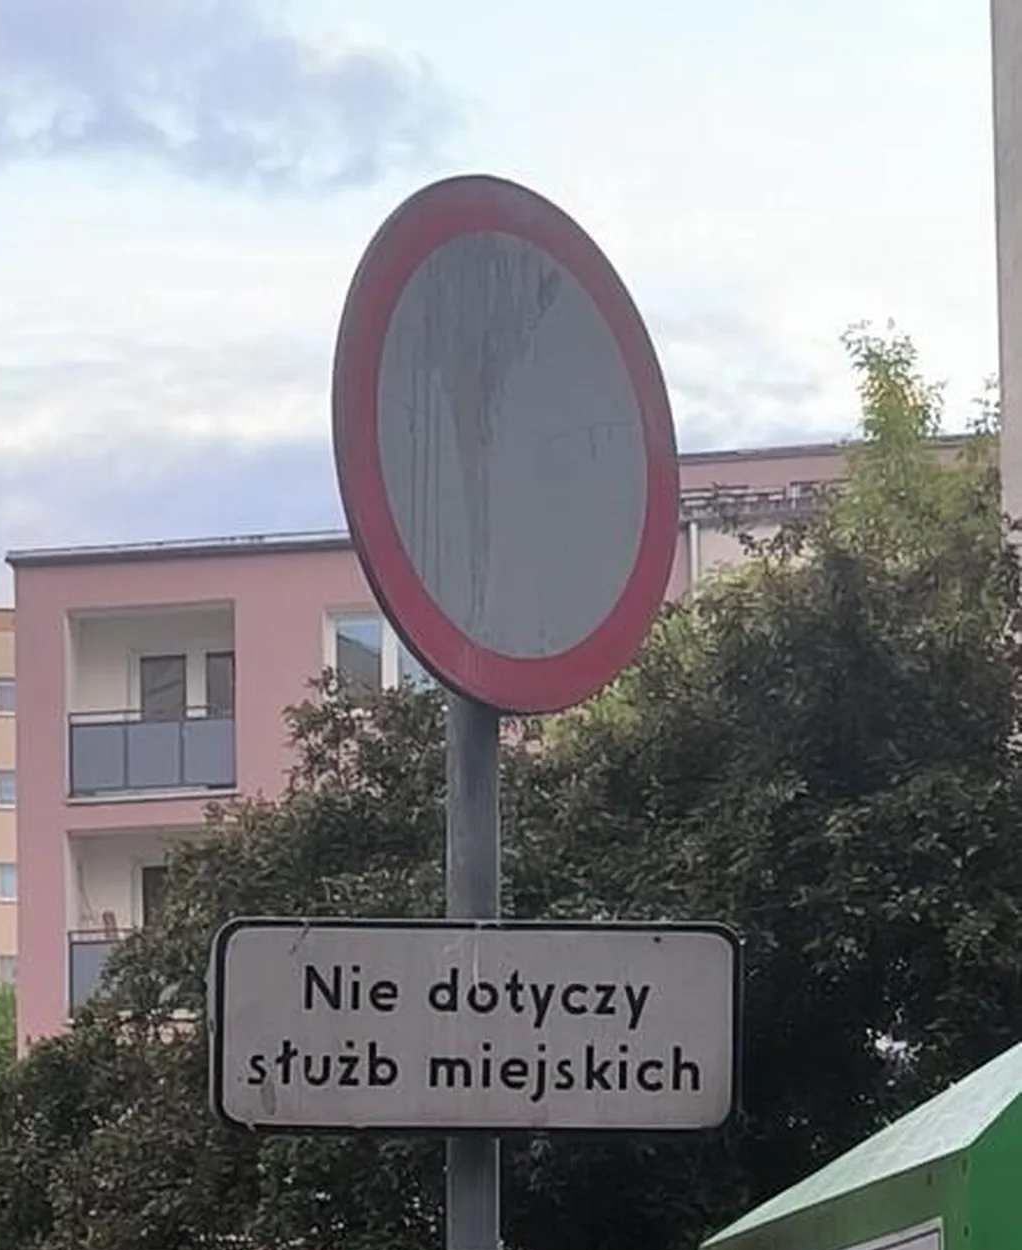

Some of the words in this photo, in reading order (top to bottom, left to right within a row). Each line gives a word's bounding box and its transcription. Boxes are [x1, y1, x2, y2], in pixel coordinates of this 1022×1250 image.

[304, 965, 399, 1012] Nie
[428, 968, 650, 1030] dotyczy
[247, 1040, 398, 1086] służb
[428, 1043, 701, 1102] miejskich
